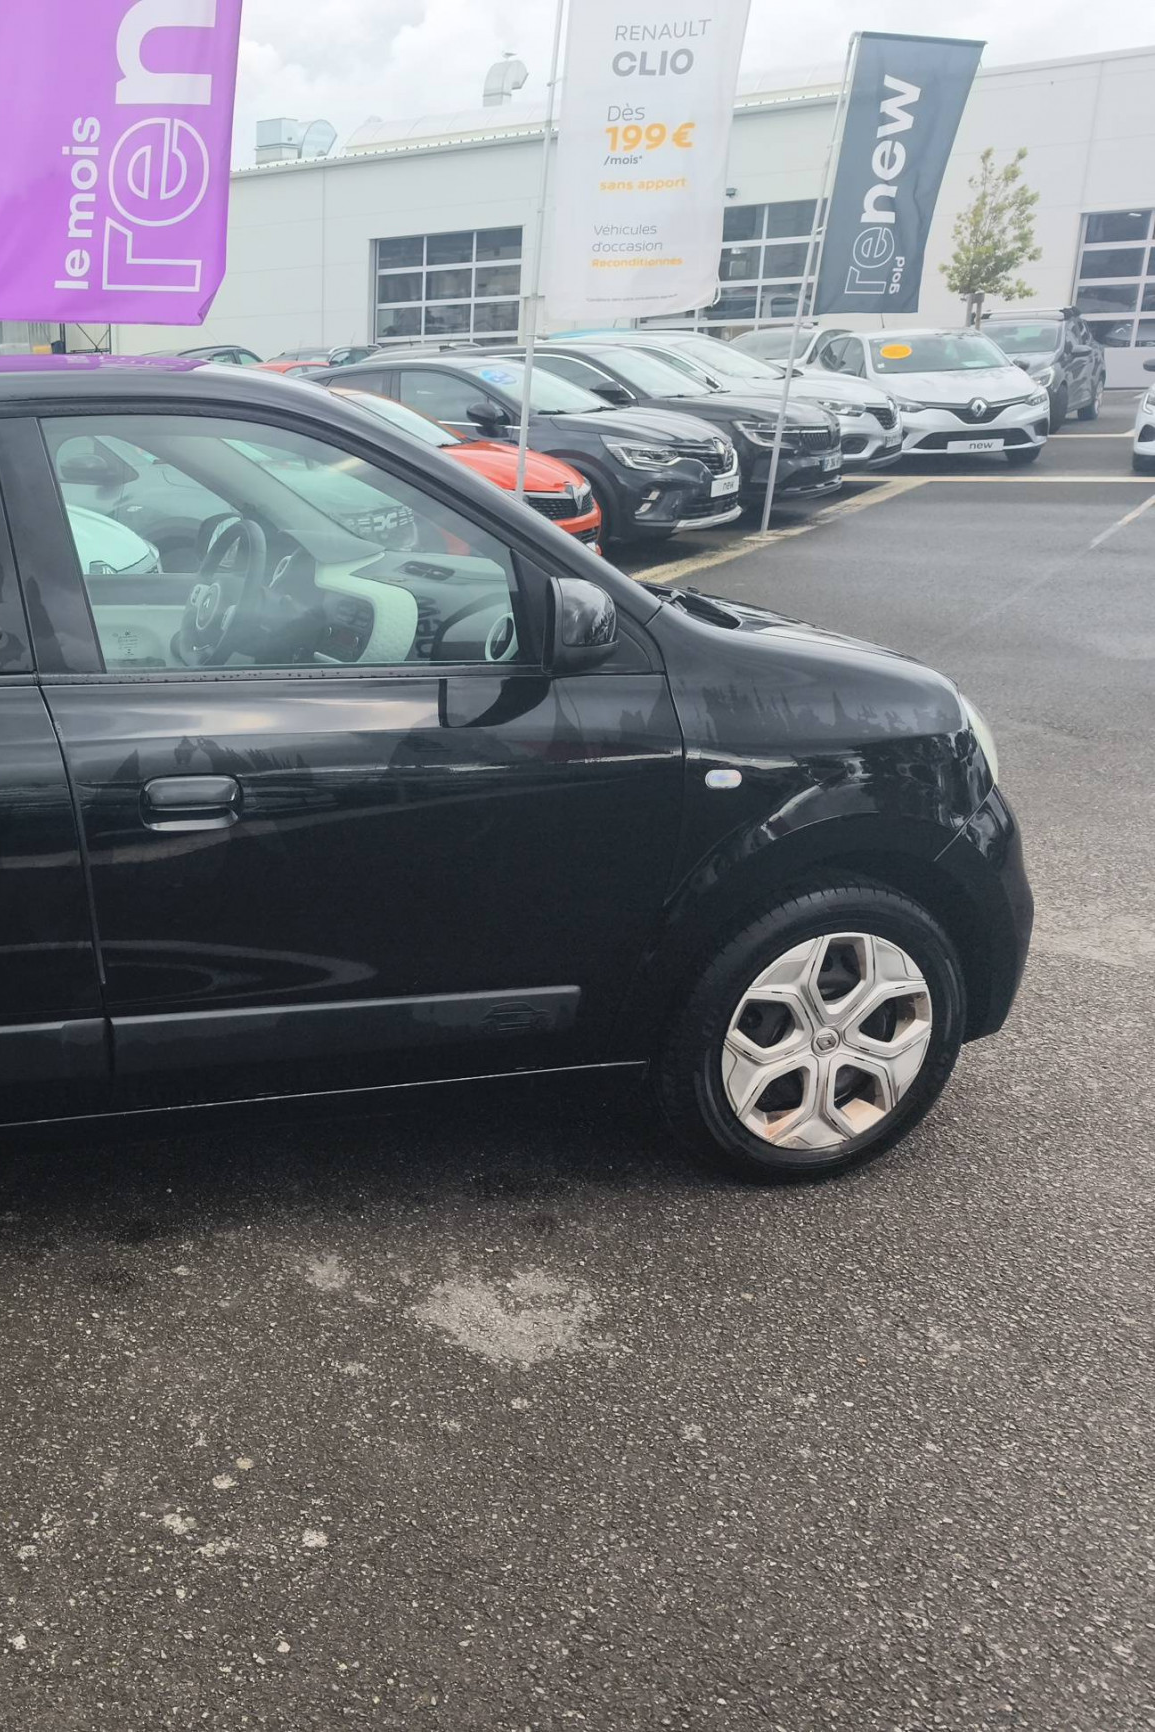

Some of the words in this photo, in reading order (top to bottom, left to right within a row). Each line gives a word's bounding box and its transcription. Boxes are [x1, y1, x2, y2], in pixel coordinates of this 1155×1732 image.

[614, 18, 712, 41] RENAULT
[612, 48, 694, 77] CLIO
[607, 103, 646, 122] Dès
[605, 123, 668, 152] 199
[672, 122, 696, 149] €
[61, 116, 101, 238] mois
[599, 181, 634, 191] sans
[637, 178, 688, 191] apport
[844, 74, 922, 295] renew
[54, 249, 91, 290] le
[888, 256, 906, 295] gold
[969, 442, 994, 450] new
